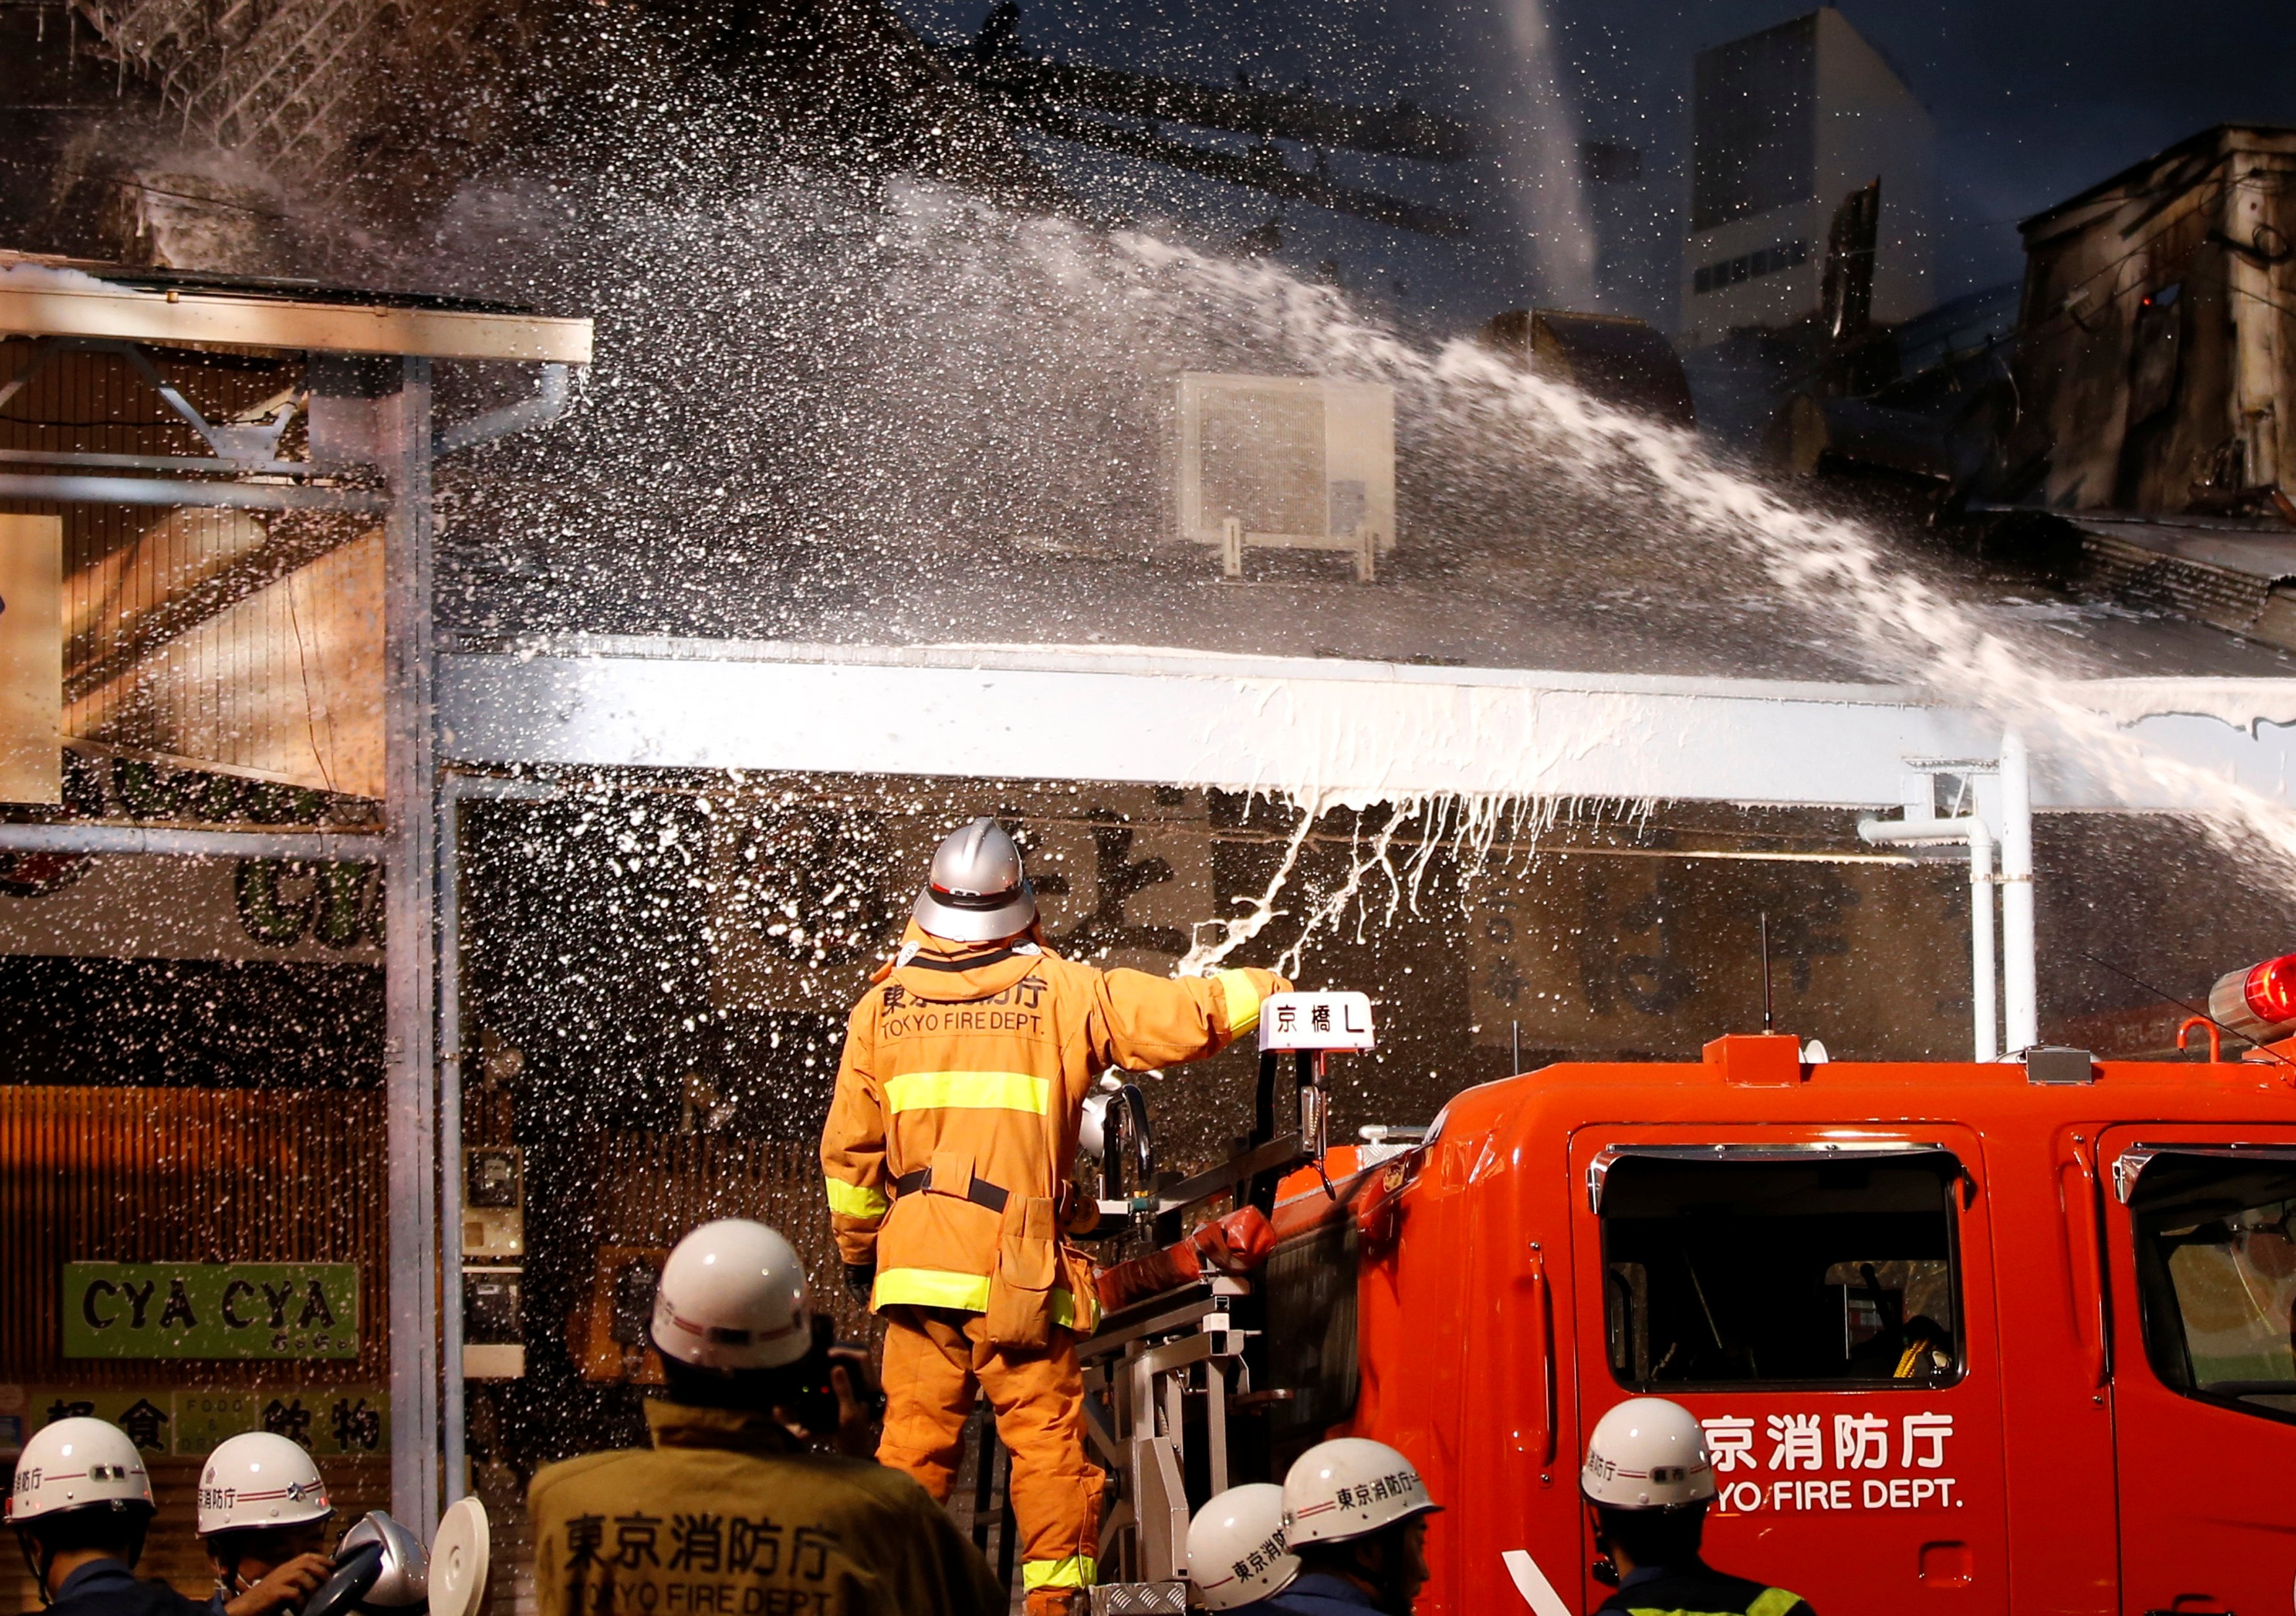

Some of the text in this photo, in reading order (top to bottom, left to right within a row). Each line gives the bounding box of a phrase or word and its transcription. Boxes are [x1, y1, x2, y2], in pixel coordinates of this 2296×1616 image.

[882, 1012, 1044, 1040] TOKYO FIRE DEPT.
[83, 1279, 337, 1330] CYA CYA
[1336, 1472, 1412, 1511] 東京消防庁
[1773, 1481, 1852, 1510] FIRE
[1863, 1478, 1963, 1509] DEPT.
[564, 1512, 842, 1581] 東京消防庁
[666, 1583, 736, 1613] FIRE
